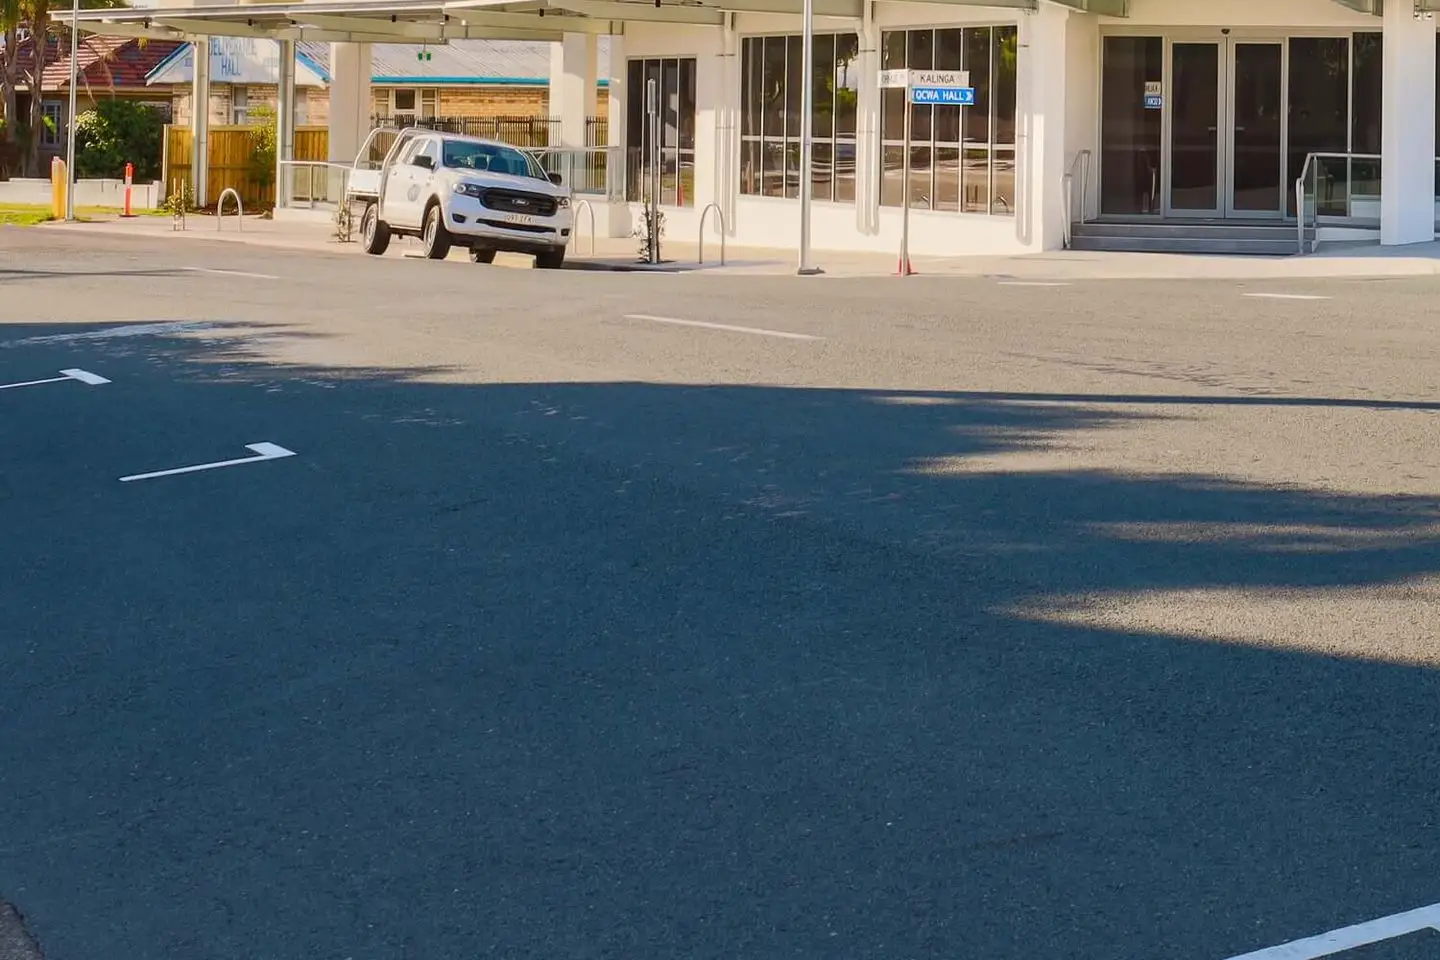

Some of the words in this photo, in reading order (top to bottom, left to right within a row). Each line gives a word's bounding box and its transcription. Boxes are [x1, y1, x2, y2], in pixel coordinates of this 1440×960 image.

[221, 56, 241, 76] HALL
[920, 74, 955, 84] KALINGA
[943, 90, 964, 100] HALL
